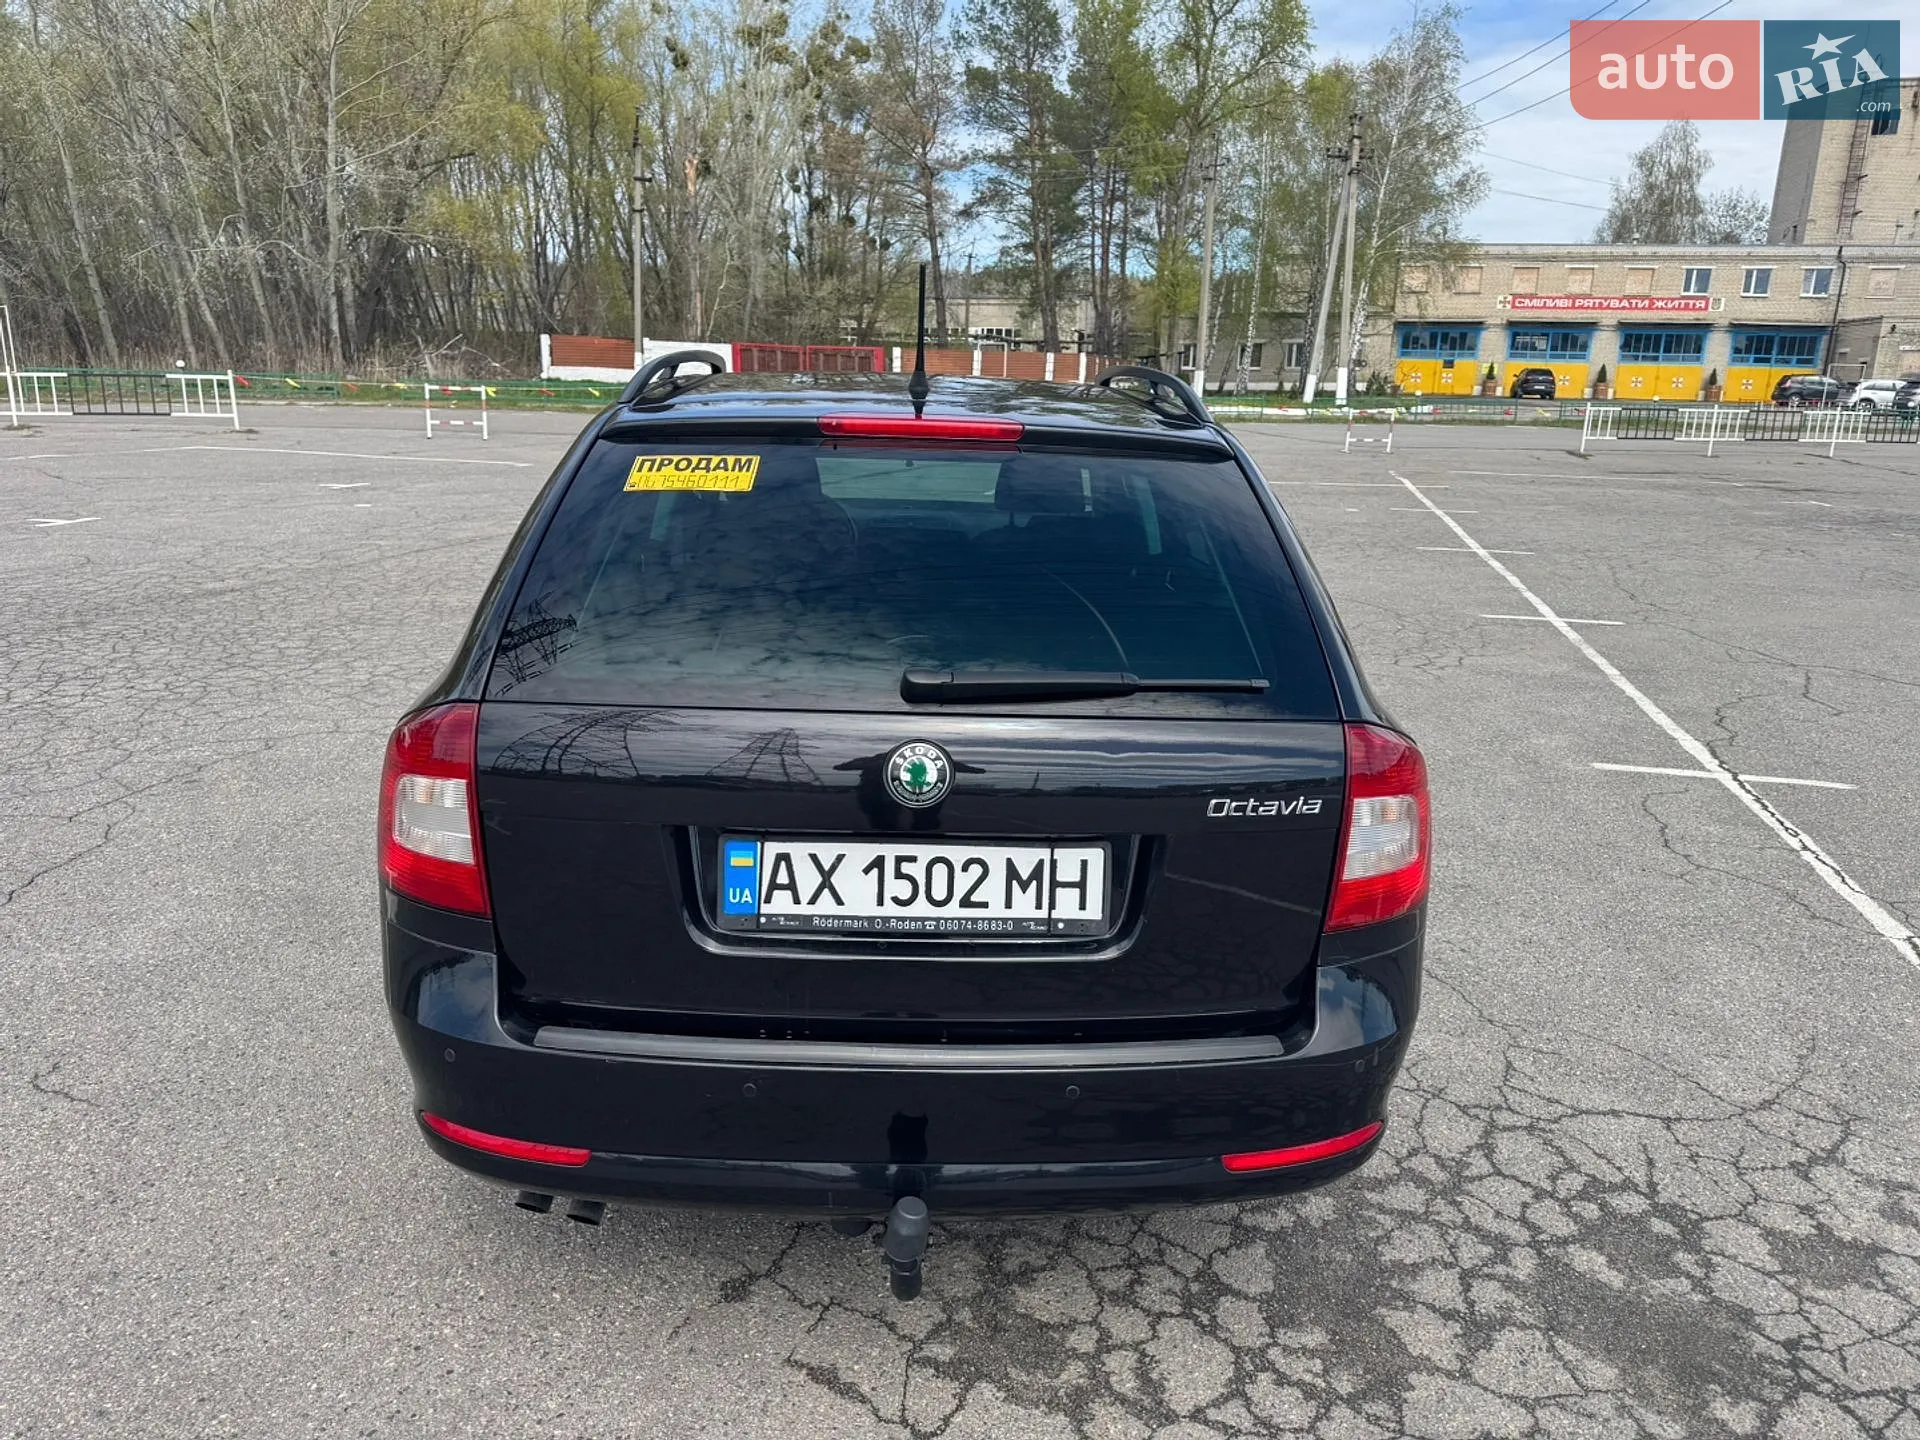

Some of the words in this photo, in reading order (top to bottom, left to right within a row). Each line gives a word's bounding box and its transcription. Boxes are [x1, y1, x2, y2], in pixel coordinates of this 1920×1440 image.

[1514, 298, 1573, 308] СМІЛИВІ
[1574, 298, 1649, 308] РЯТУВАТИ
[1652, 298, 1706, 309] ЖИТТЯ
[636, 457, 754, 473] ПРОДАМ
[1206, 796, 1323, 816] Octavia
[763, 852, 847, 906] AX
[861, 854, 990, 908] 1502
[1004, 857, 1088, 911] MH
[729, 888, 753, 903] UA
